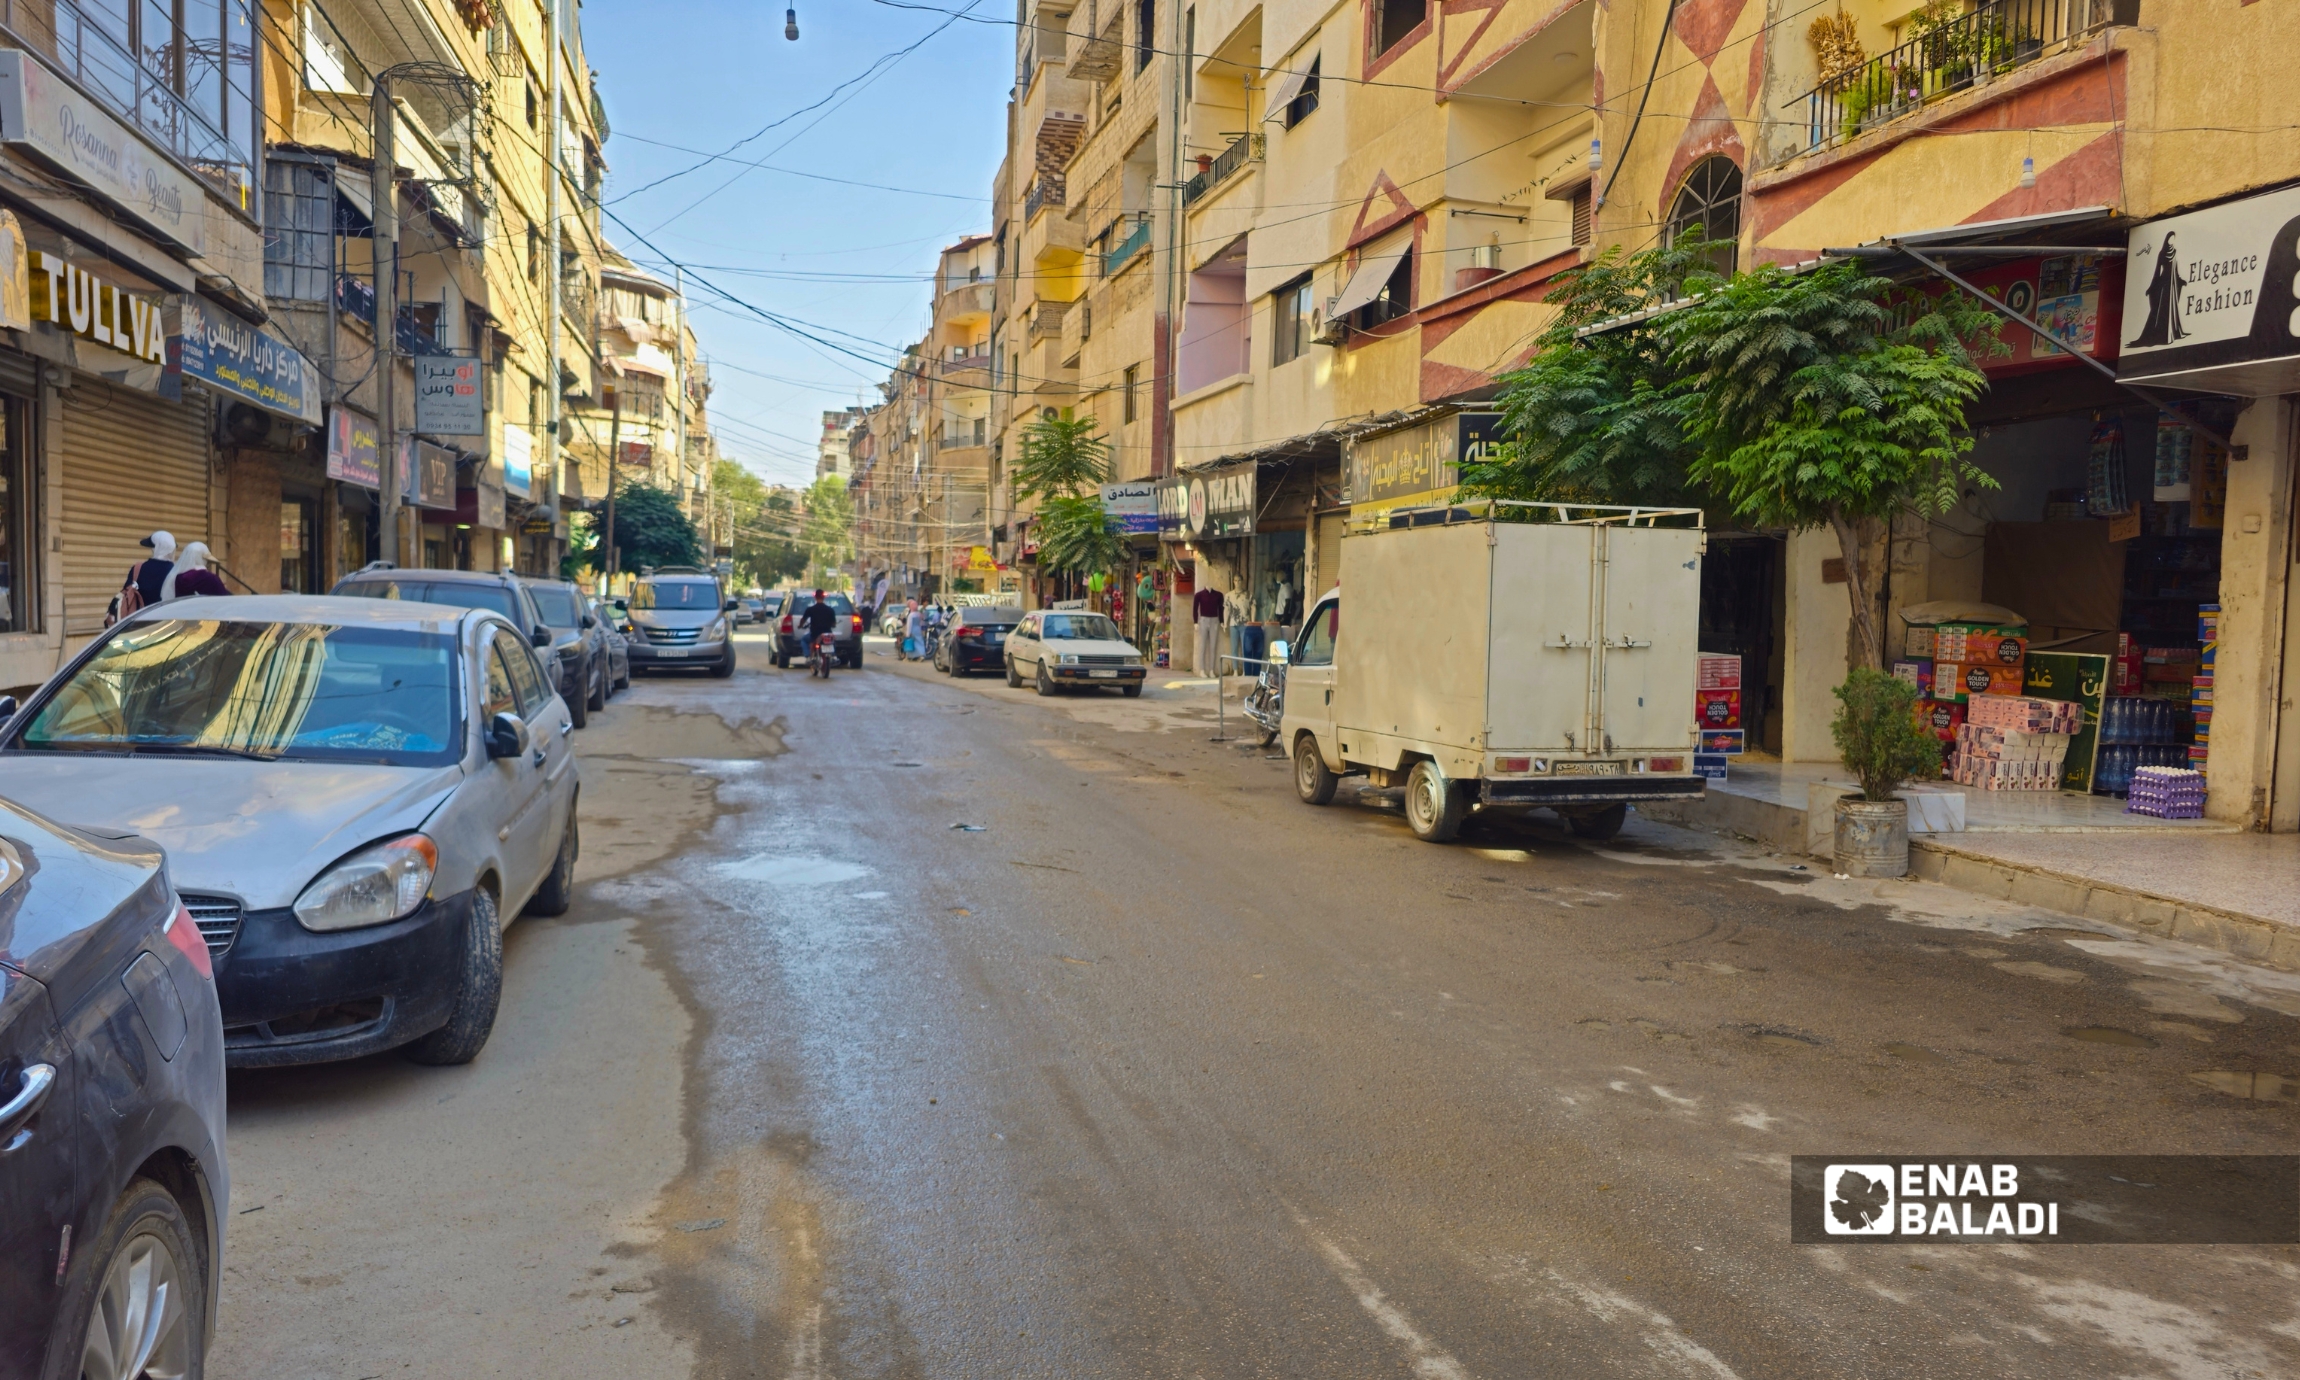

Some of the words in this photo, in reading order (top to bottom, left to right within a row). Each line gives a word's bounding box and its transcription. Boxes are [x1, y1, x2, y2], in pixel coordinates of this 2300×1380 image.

[59, 104, 118, 171] Rosanna
[145, 168, 182, 226] Beauty
[2188, 254, 2257, 285] Elegance
[41, 252, 167, 365] TULLVA
[2185, 287, 2253, 316] Fashion
[207, 323, 251, 363] الرئيسي
[253, 335, 273, 374] داريا
[275, 348, 299, 386] مركز
[422, 383, 476, 397] هاوس
[1372, 450, 1398, 492] المحبة
[1413, 442, 1430, 485] تاج
[1157, 486, 1188, 519] LORD
[1208, 473, 1253, 515] MAN
